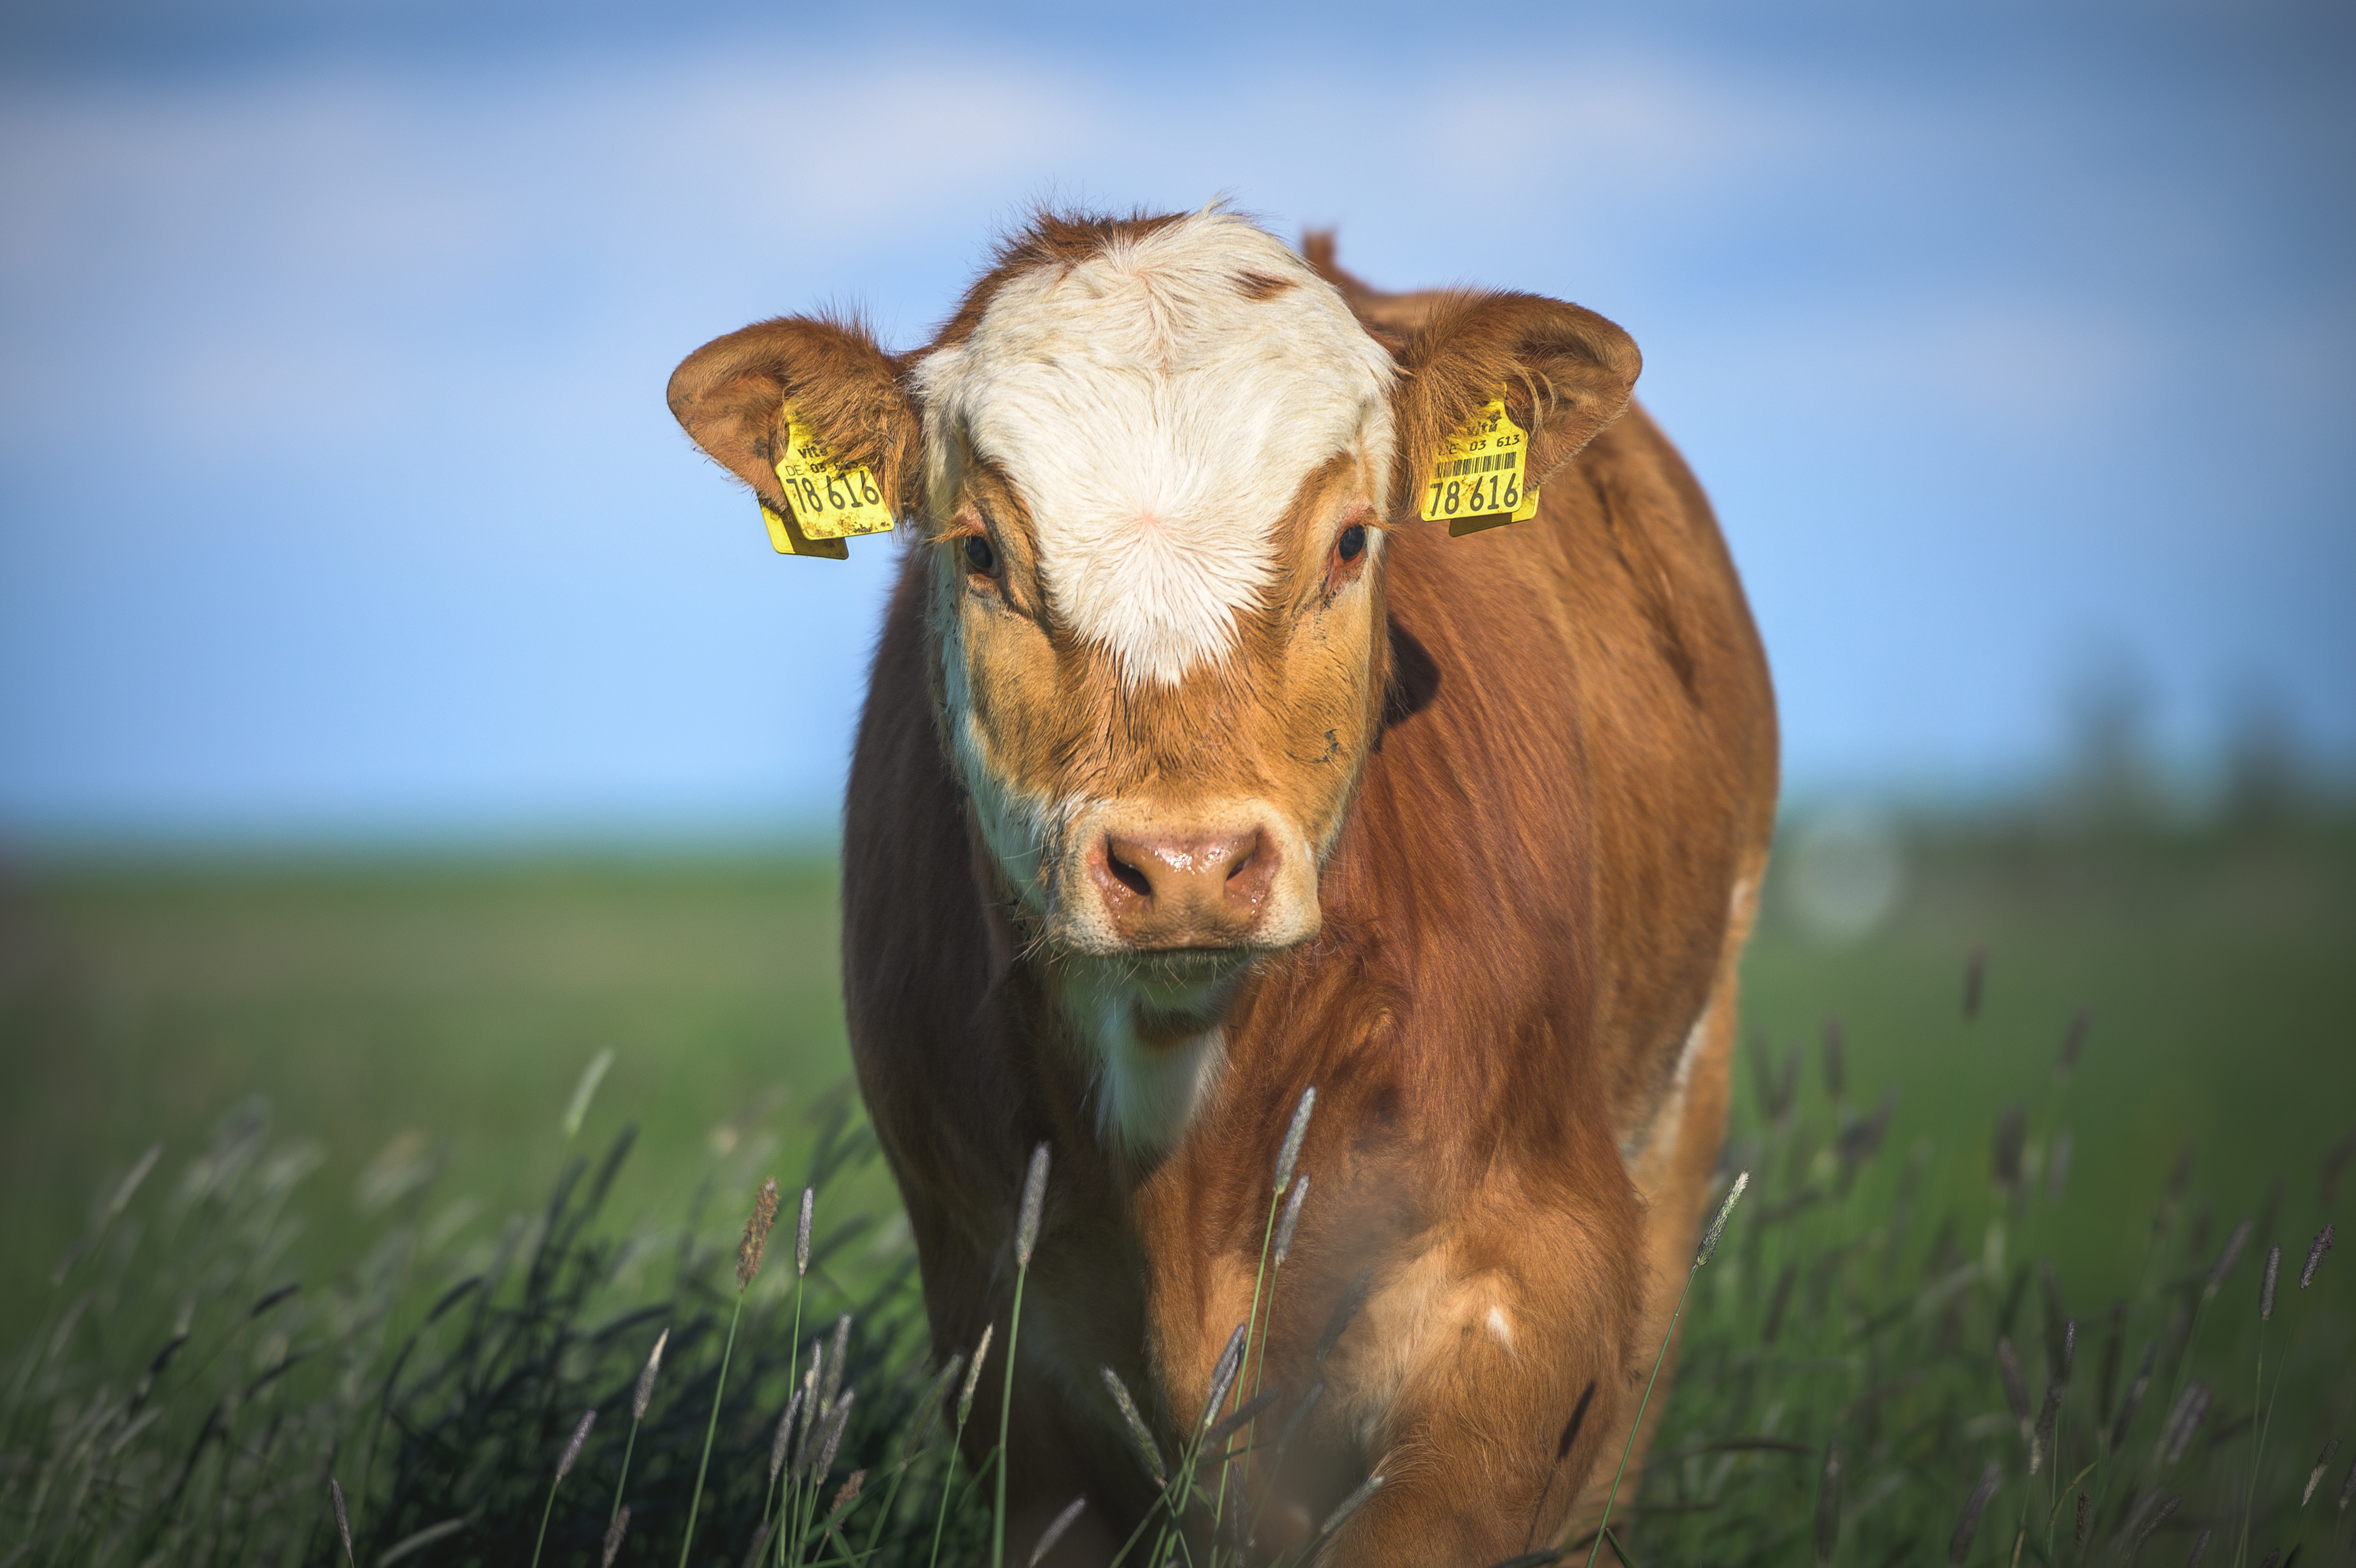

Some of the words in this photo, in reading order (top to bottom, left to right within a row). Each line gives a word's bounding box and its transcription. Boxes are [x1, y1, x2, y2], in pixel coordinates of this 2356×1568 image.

[1469, 440, 1487, 451] 03
[1496, 434, 1520, 447] 613
[785, 465, 805, 476] DE
[810, 463, 827, 473] 03
[786, 477, 823, 513] 78
[826, 470, 880, 510] 616
[1430, 480, 1460, 517] 78
[1470, 473, 1518, 511] 616
